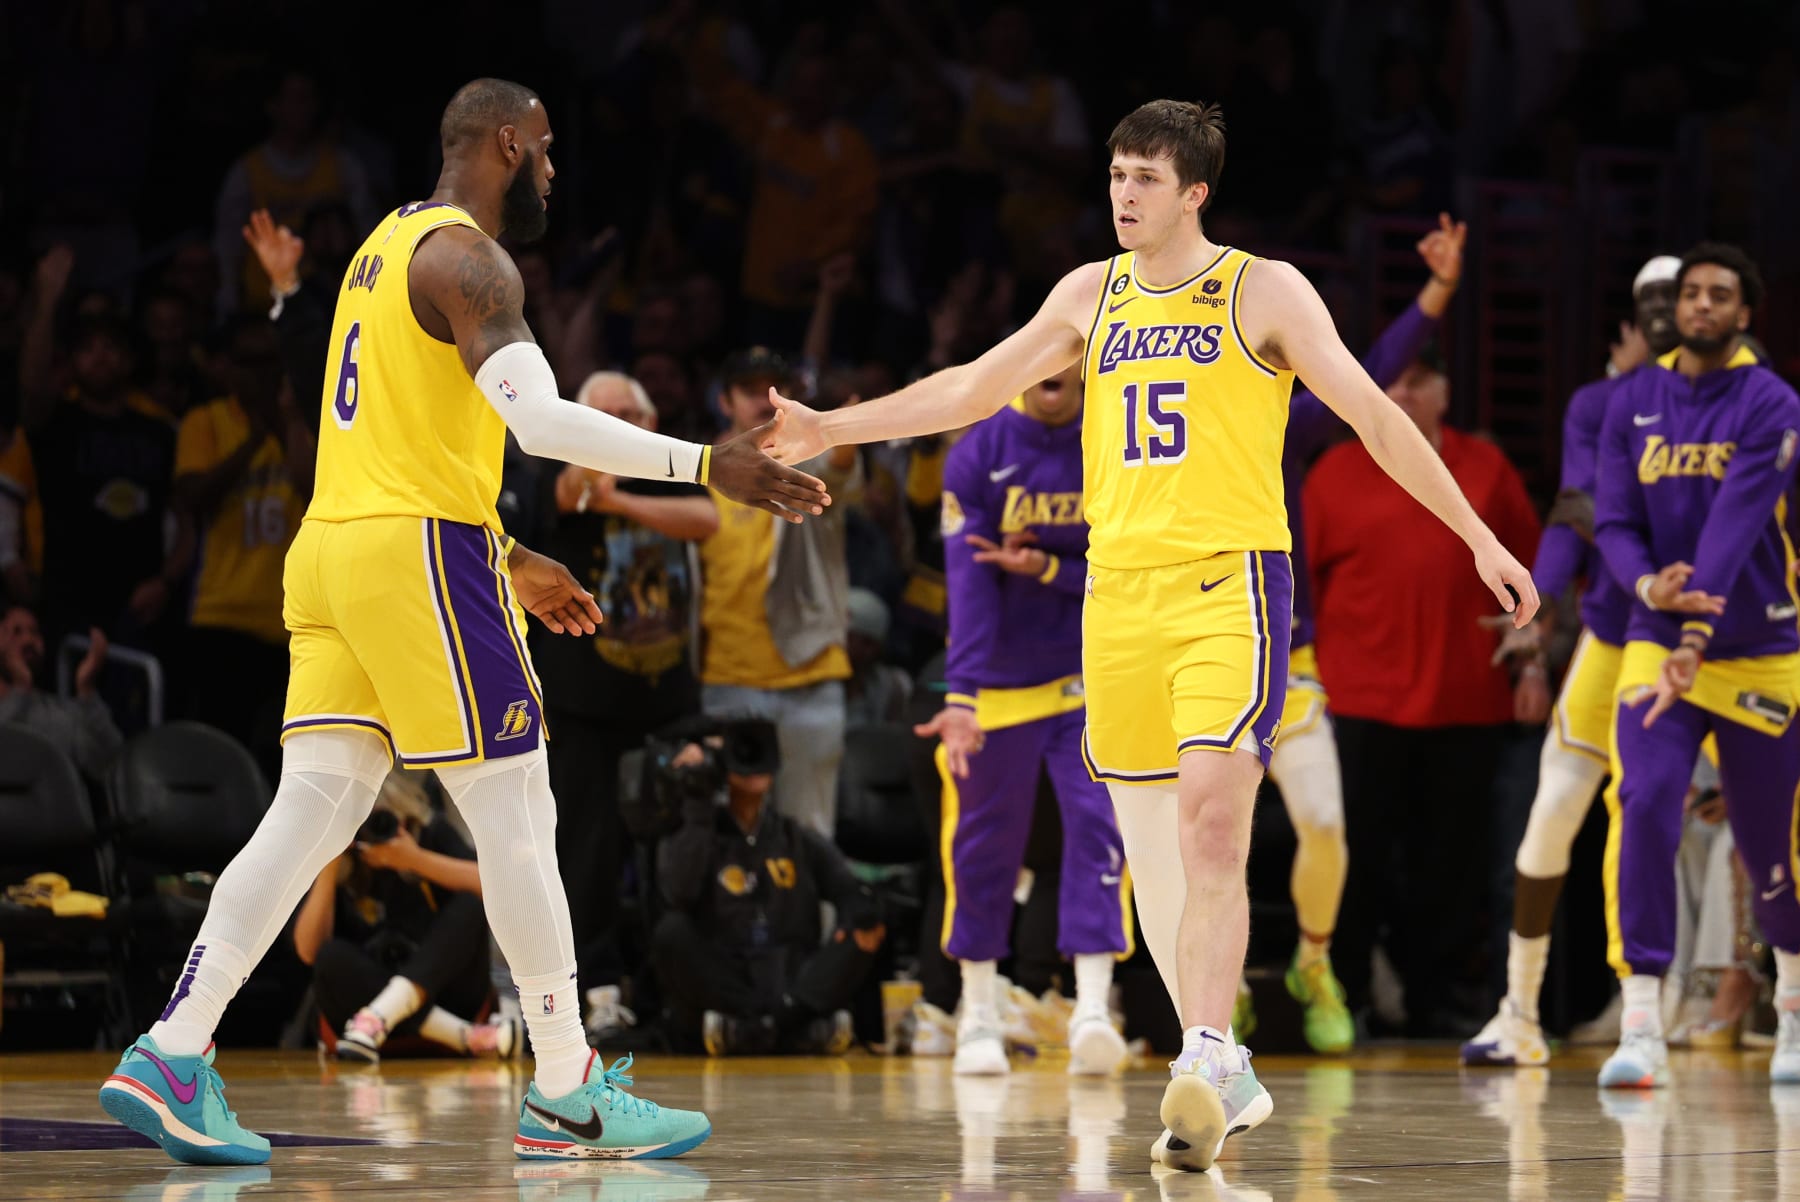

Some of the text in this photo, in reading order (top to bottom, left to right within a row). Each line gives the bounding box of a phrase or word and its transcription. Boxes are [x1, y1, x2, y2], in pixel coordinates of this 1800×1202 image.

[1114, 275, 1128, 294] 6
[1191, 294, 1226, 309] bibigo
[331, 319, 360, 430] 6
[1097, 320, 1224, 376] LAKERS
[1122, 380, 1187, 467] 15
